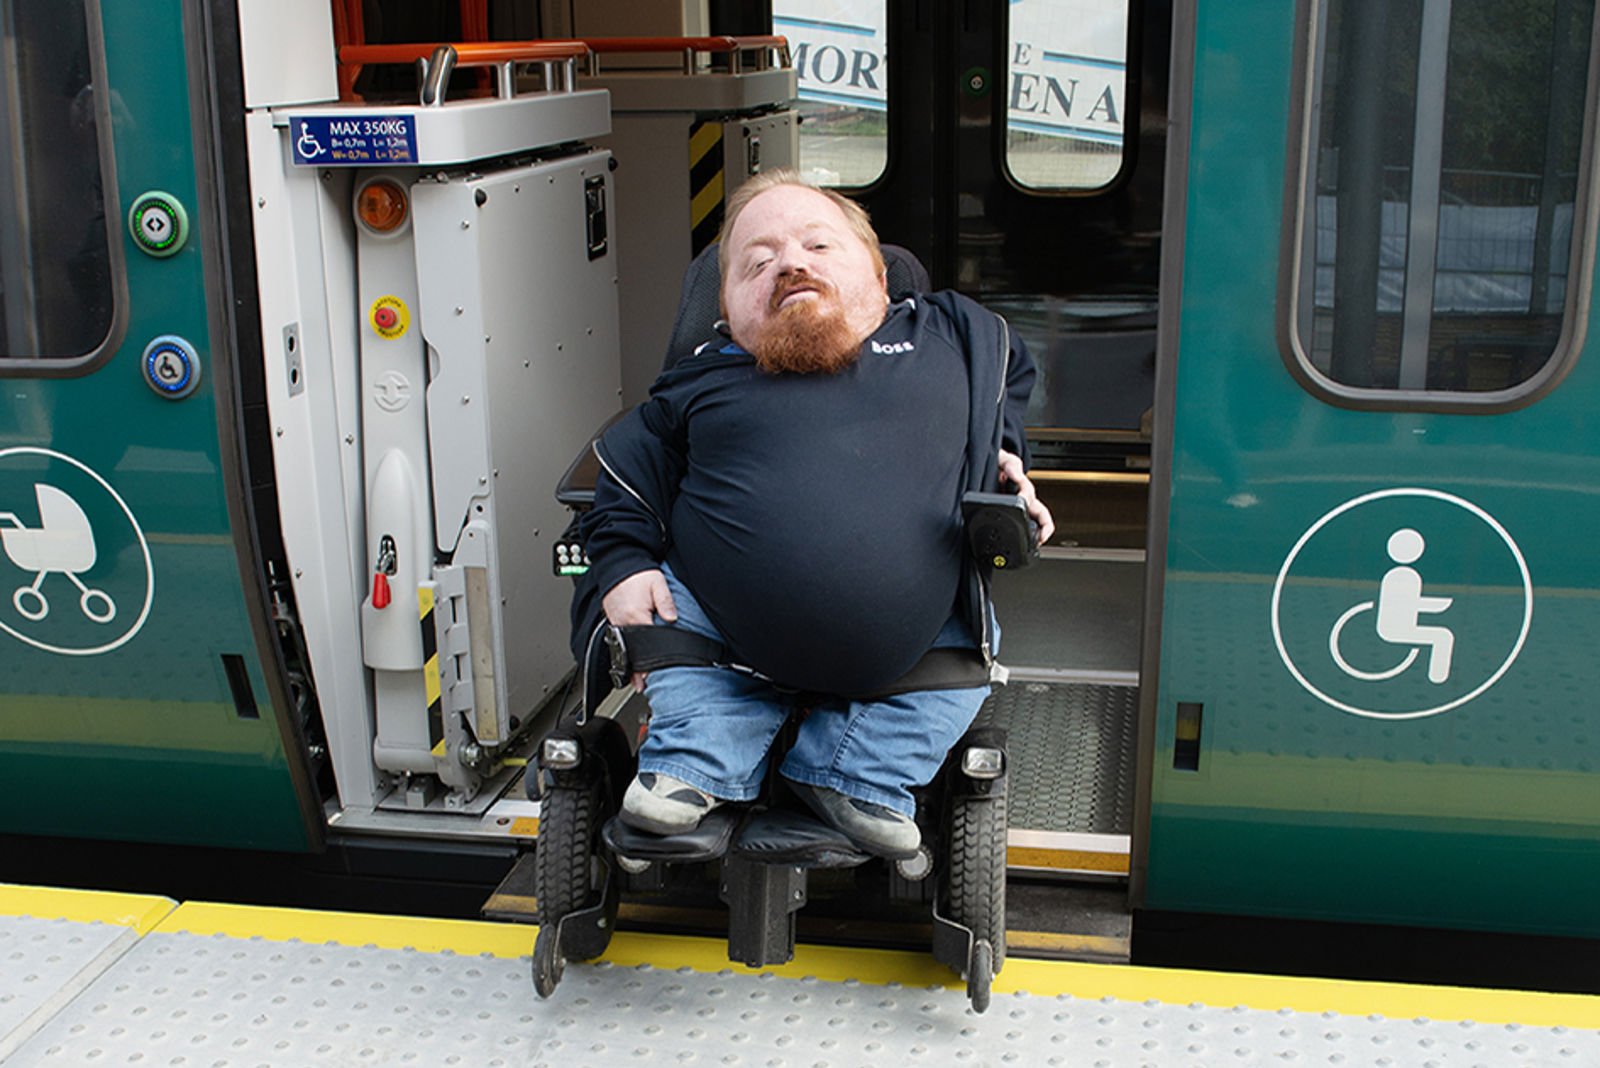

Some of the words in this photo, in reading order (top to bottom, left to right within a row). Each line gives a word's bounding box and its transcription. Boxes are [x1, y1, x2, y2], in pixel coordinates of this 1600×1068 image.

[329, 121, 361, 136] MAX
[363, 120, 407, 136] 350KG
[871, 340, 914, 355] BOSS
